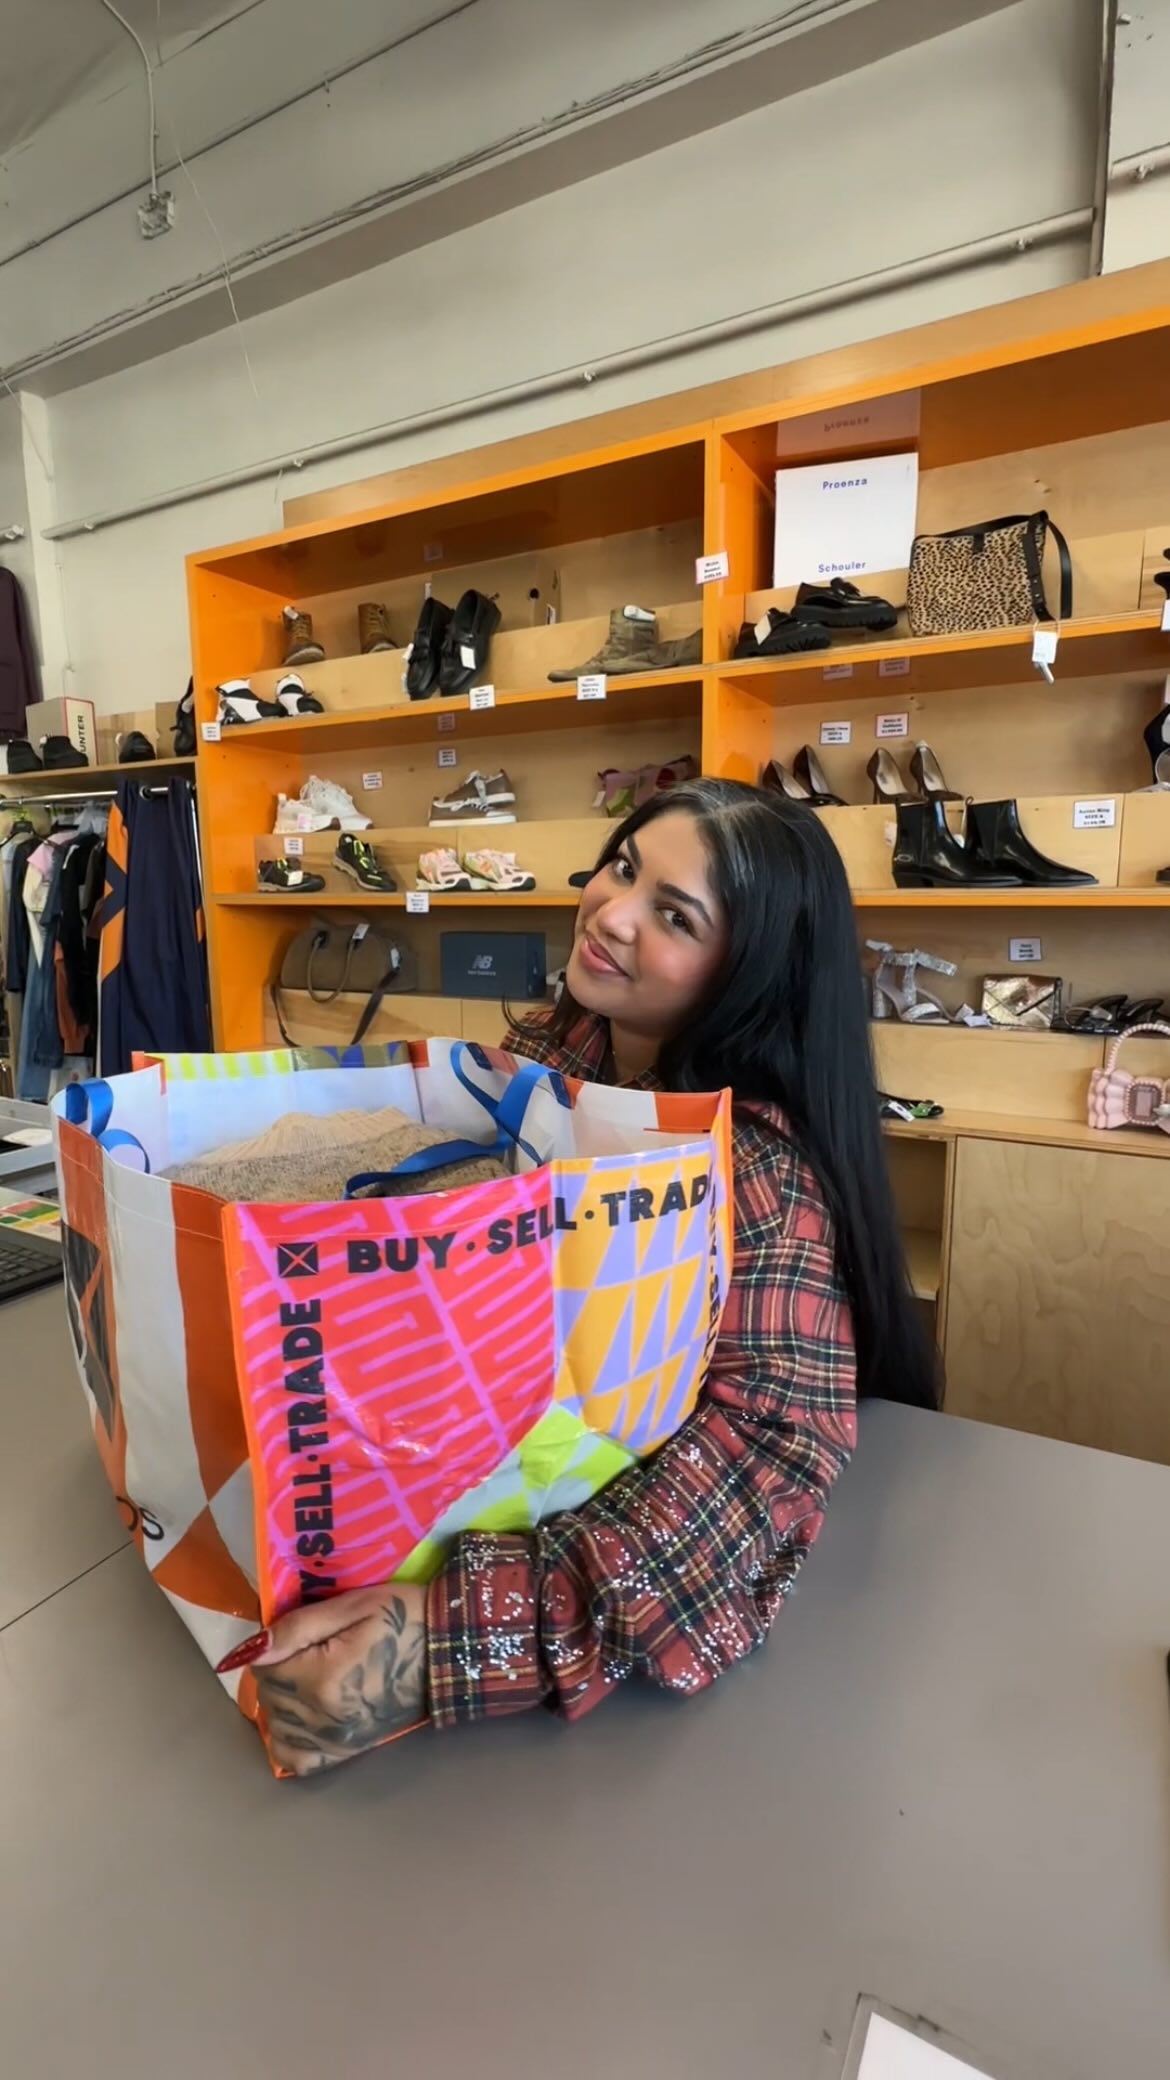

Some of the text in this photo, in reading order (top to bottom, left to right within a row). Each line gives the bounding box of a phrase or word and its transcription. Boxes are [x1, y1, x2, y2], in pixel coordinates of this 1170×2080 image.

[822, 478, 868, 490] Proenza
[818, 561, 866, 573] Schouler
[77, 715, 86, 752] UNTER
